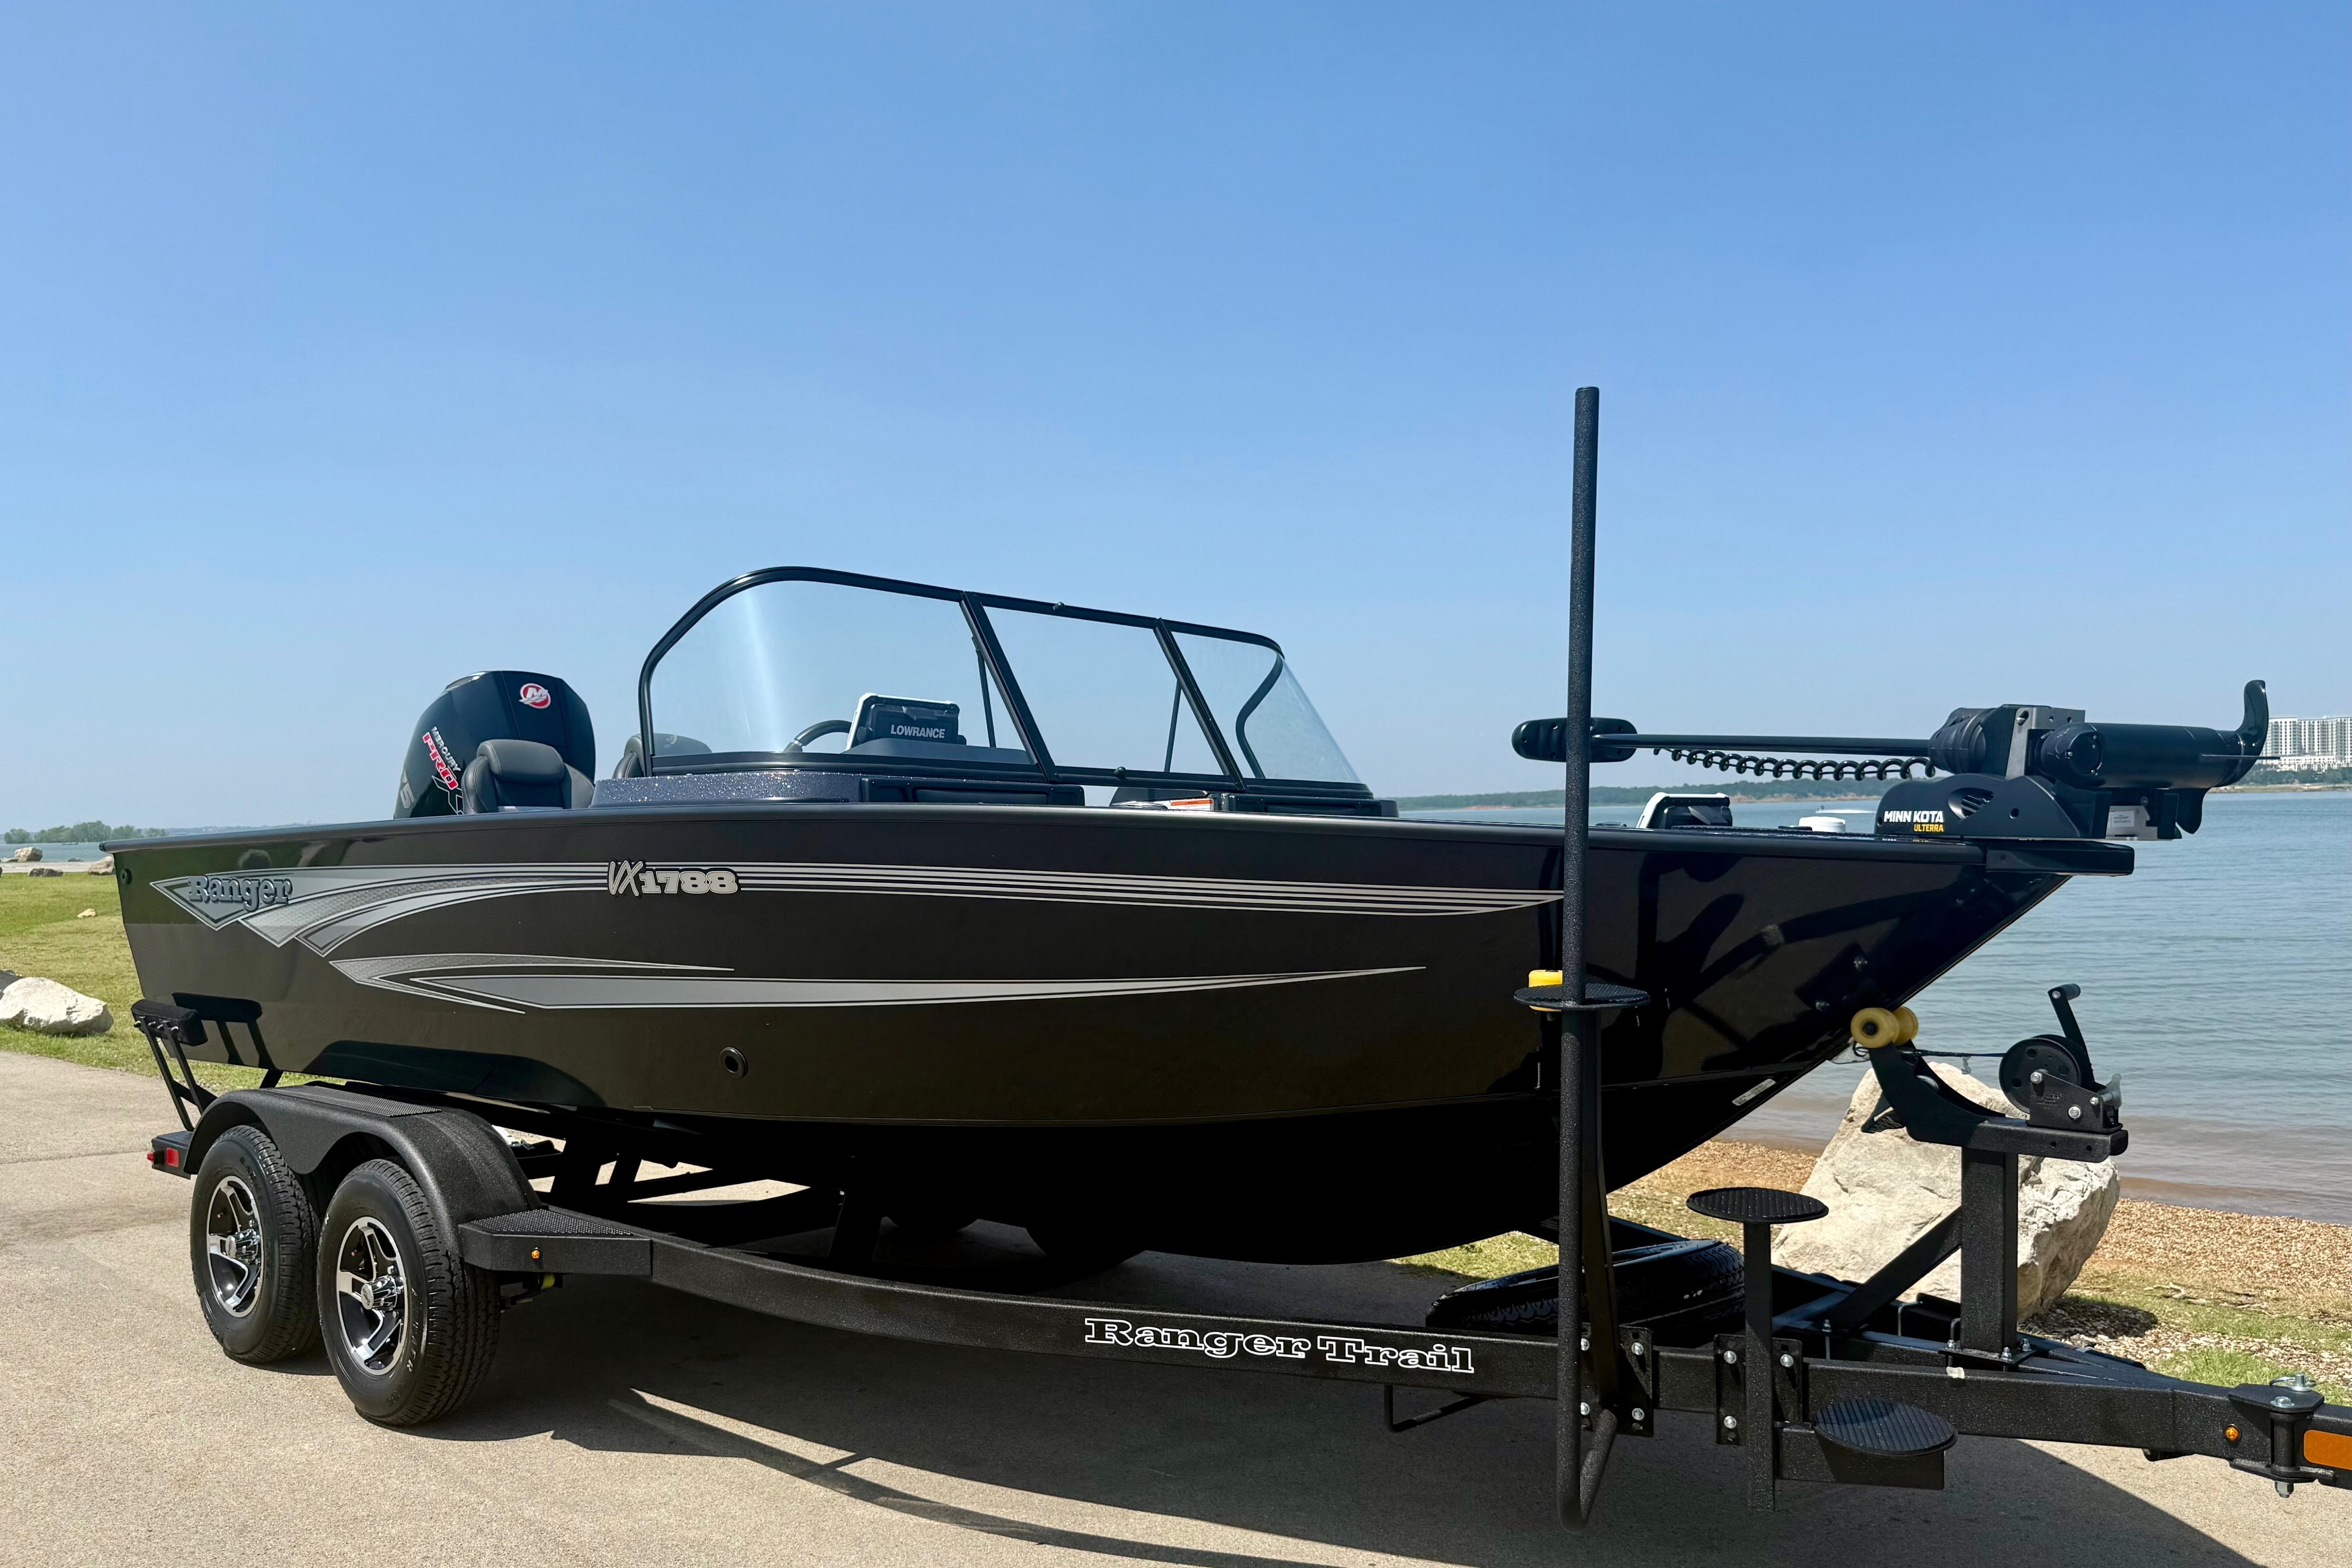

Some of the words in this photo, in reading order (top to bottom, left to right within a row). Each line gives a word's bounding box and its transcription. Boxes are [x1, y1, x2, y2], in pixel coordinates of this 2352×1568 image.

[431, 726, 461, 771] MERCURY
[891, 724, 945, 739] LOWRANCE
[422, 731, 459, 790] PRO
[1884, 810, 1912, 822] MINN
[1913, 810, 1944, 823] KOTA
[1914, 824, 1944, 832] ULTERRA
[188, 876, 293, 912] Ranger
[1085, 1318, 1311, 1358] Ranger
[1317, 1335, 1475, 1373] Trail
